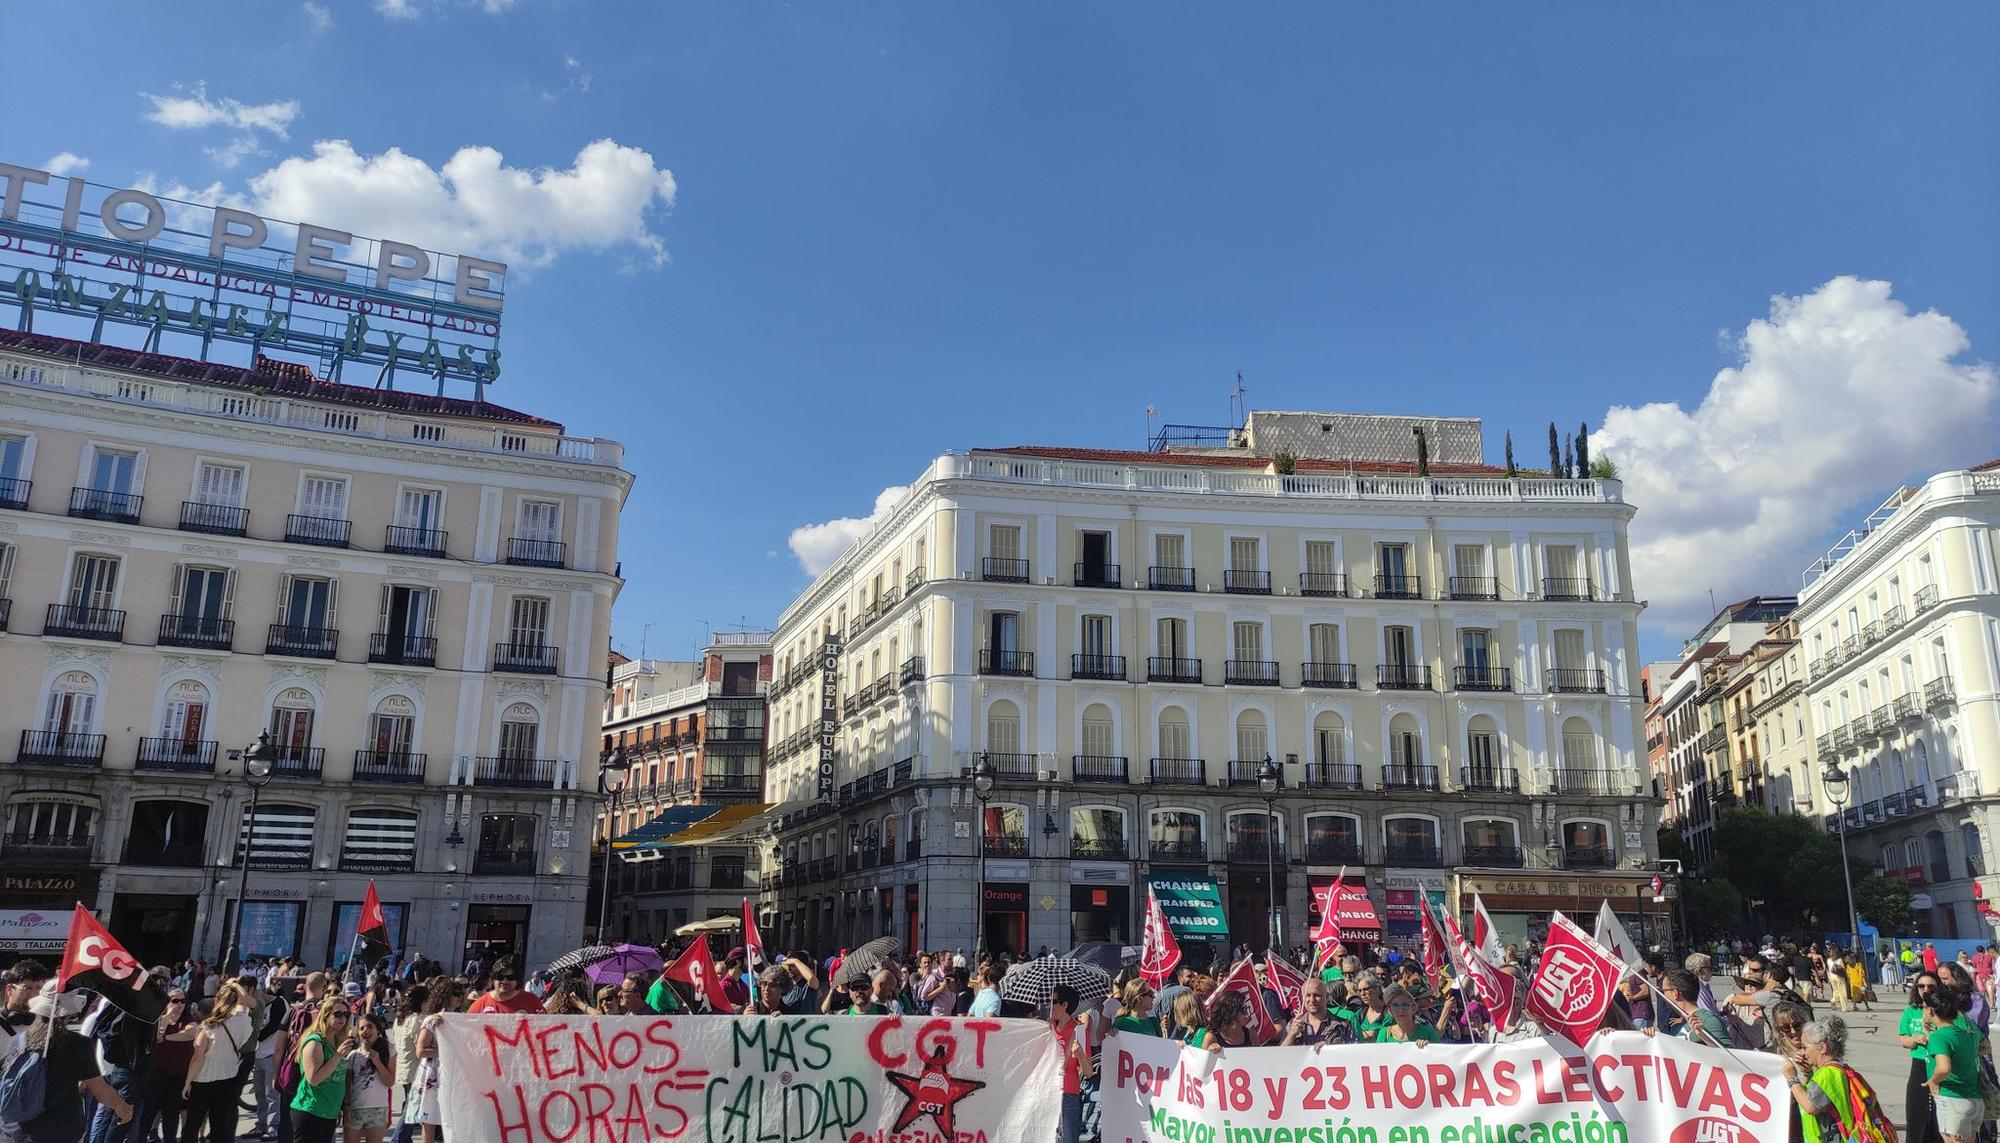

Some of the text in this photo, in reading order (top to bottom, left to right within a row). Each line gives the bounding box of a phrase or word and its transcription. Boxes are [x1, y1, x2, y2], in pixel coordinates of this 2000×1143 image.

[0, 163, 507, 311] TIO PEPE
[48, 240, 90, 264] DE
[103, 253, 277, 299] ANDALUCIA
[292, 286, 499, 337] EMBOTELLADO
[343, 312, 501, 380] BYASS
[820, 643, 839, 804] HOTEL EUROPA
[5, 877, 76, 890] PALAZZO
[473, 893, 531, 901] SEPHORA
[984, 890, 1023, 901] Orange
[1152, 881, 1211, 891] CHANGE
[1495, 882, 1628, 896] CASA DE DIEGO
[1169, 916, 1219, 926] AMBIO
[1340, 930, 1380, 940] HANGE
[1535, 949, 1581, 1011] UGT
[484, 1019, 680, 1081] MENOS
[733, 1018, 832, 1072] MÁS
[867, 1018, 1002, 1069] CGT
[918, 1101, 944, 1114] CGT
[1117, 1050, 1772, 1123] Por las 18 y 23 HORAS LECTIVAS
[484, 1079, 689, 1143] HORAS
[1224, 1117, 1377, 1143] inversión
[1389, 1124, 1430, 1143] en
[1441, 1110, 1629, 1143] educación
[1696, 1119, 1741, 1143] UGT
